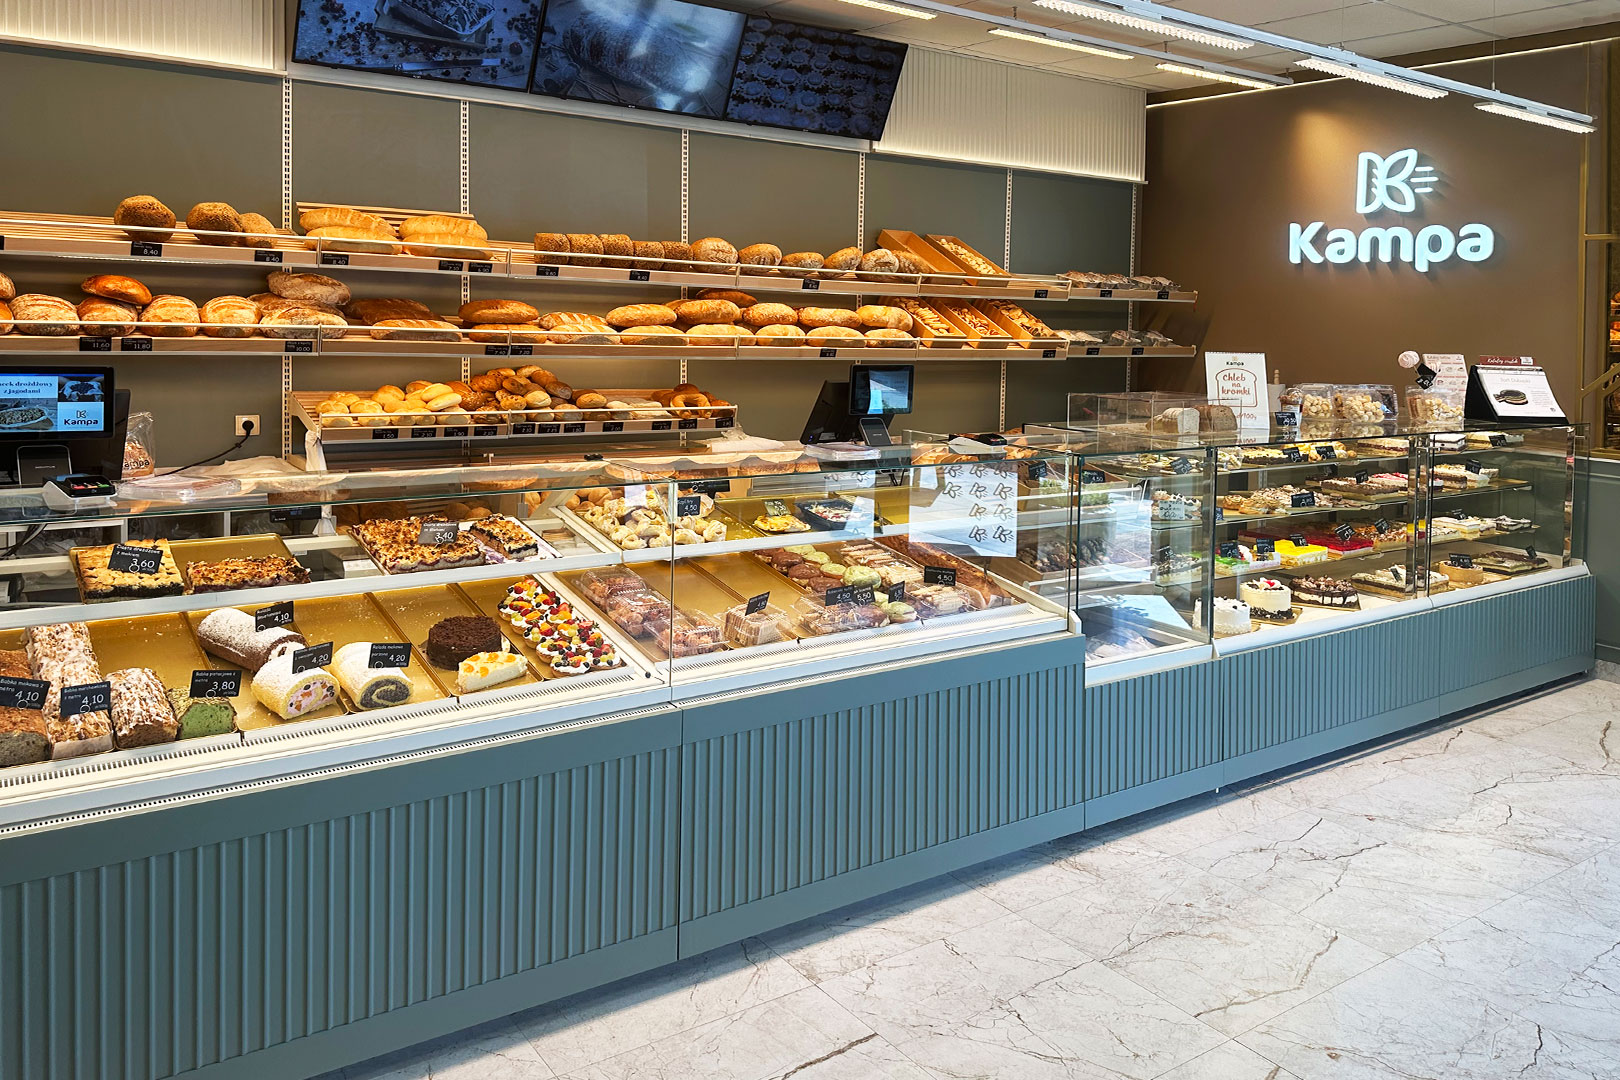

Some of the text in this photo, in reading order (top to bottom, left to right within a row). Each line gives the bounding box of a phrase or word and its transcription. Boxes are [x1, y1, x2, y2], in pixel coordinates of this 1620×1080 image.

[1289, 221, 1495, 272] Kampa
[1222, 372, 1246, 382] Chleb
[1221, 386, 1251, 395] kromki
[64, 418, 99, 426] Kampa
